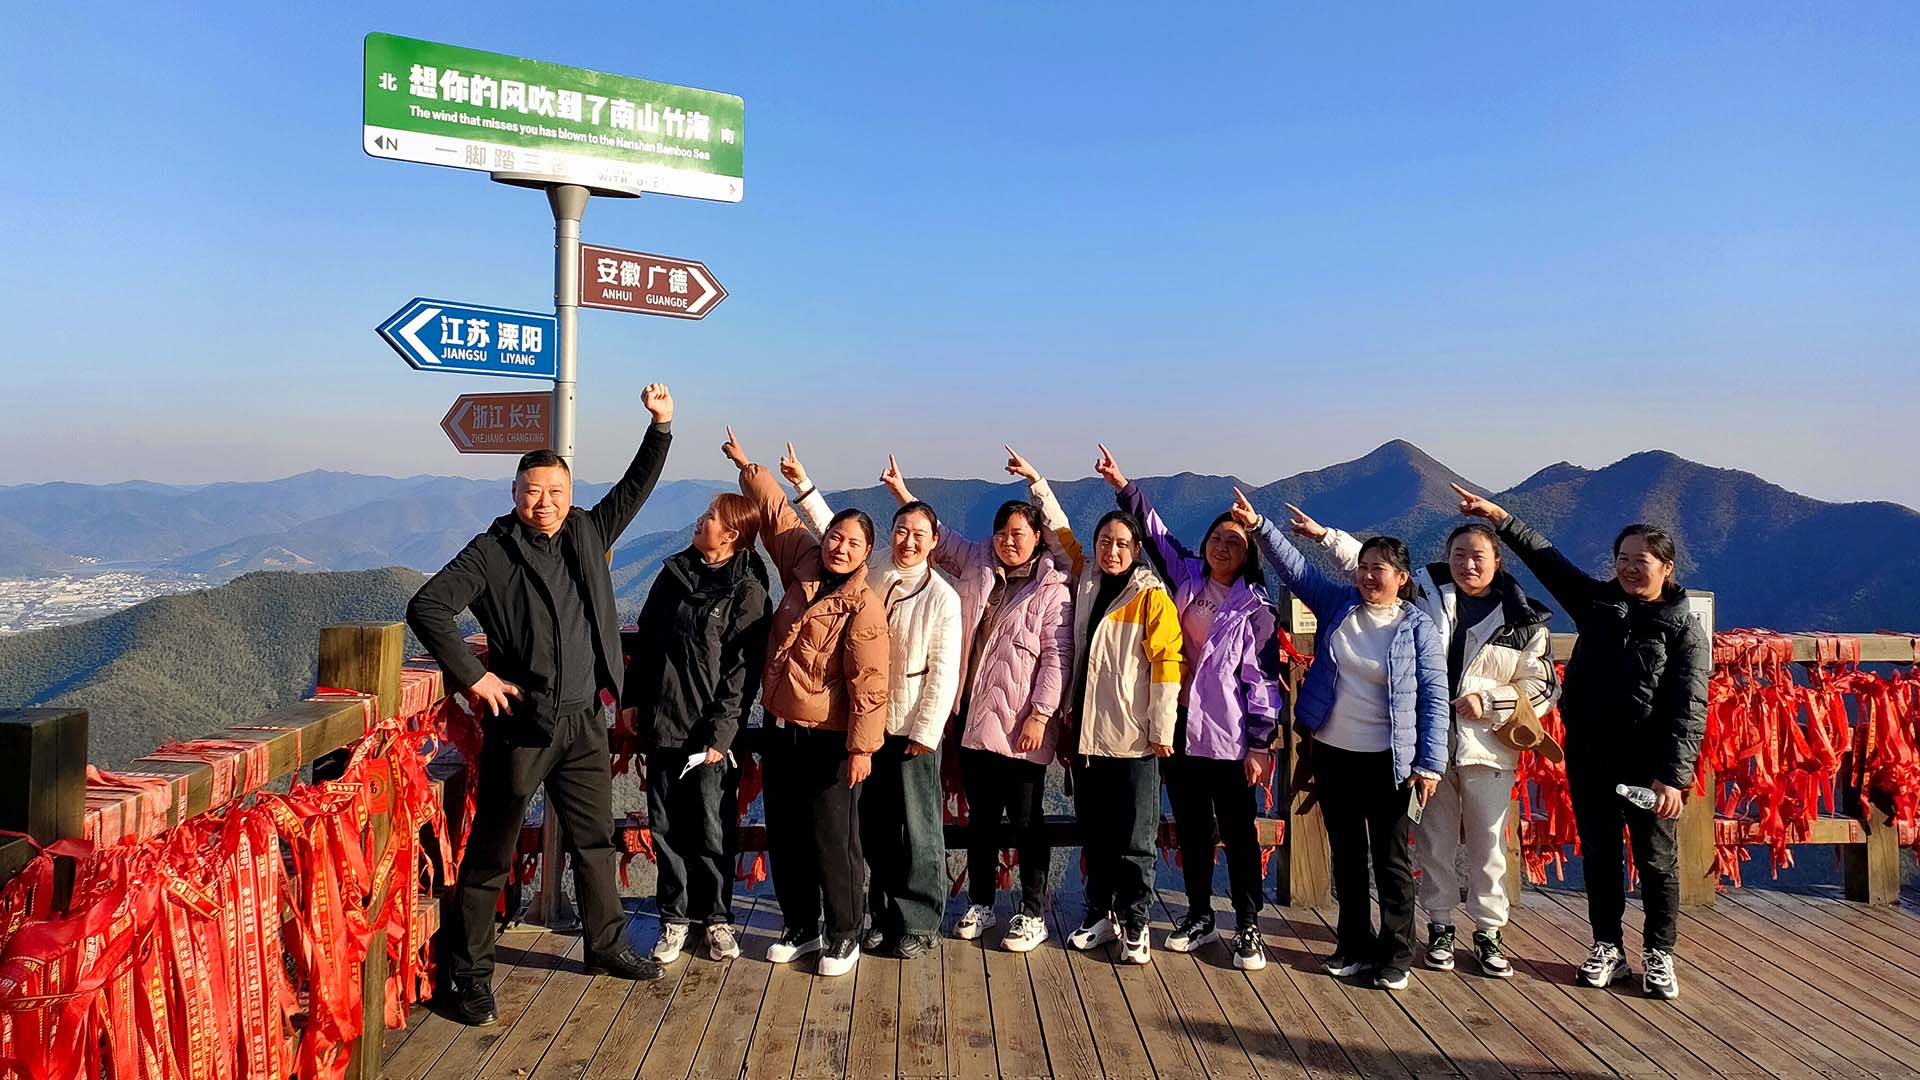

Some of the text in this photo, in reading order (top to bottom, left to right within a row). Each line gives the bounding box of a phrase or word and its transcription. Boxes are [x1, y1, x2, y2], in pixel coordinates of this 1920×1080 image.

[378, 72, 398, 91] 北
[408, 63, 710, 142] 想你的风吹到了南山竹海
[409, 104, 710, 160] The wind that misses you has blown to the Nanshan Bamboo Sea
[721, 128, 735, 144] 南
[386, 136, 398, 151] N
[597, 257, 689, 295] 安徽 广德
[602, 287, 688, 309] ANHUI GUANGDE
[440, 315, 543, 353] 江苏 溧阳
[441, 347, 536, 367] JIANGSU LIYANG
[472, 403, 541, 429] 浙江 长兴
[471, 432, 545, 444] ZHEJIANG CHANGXING
